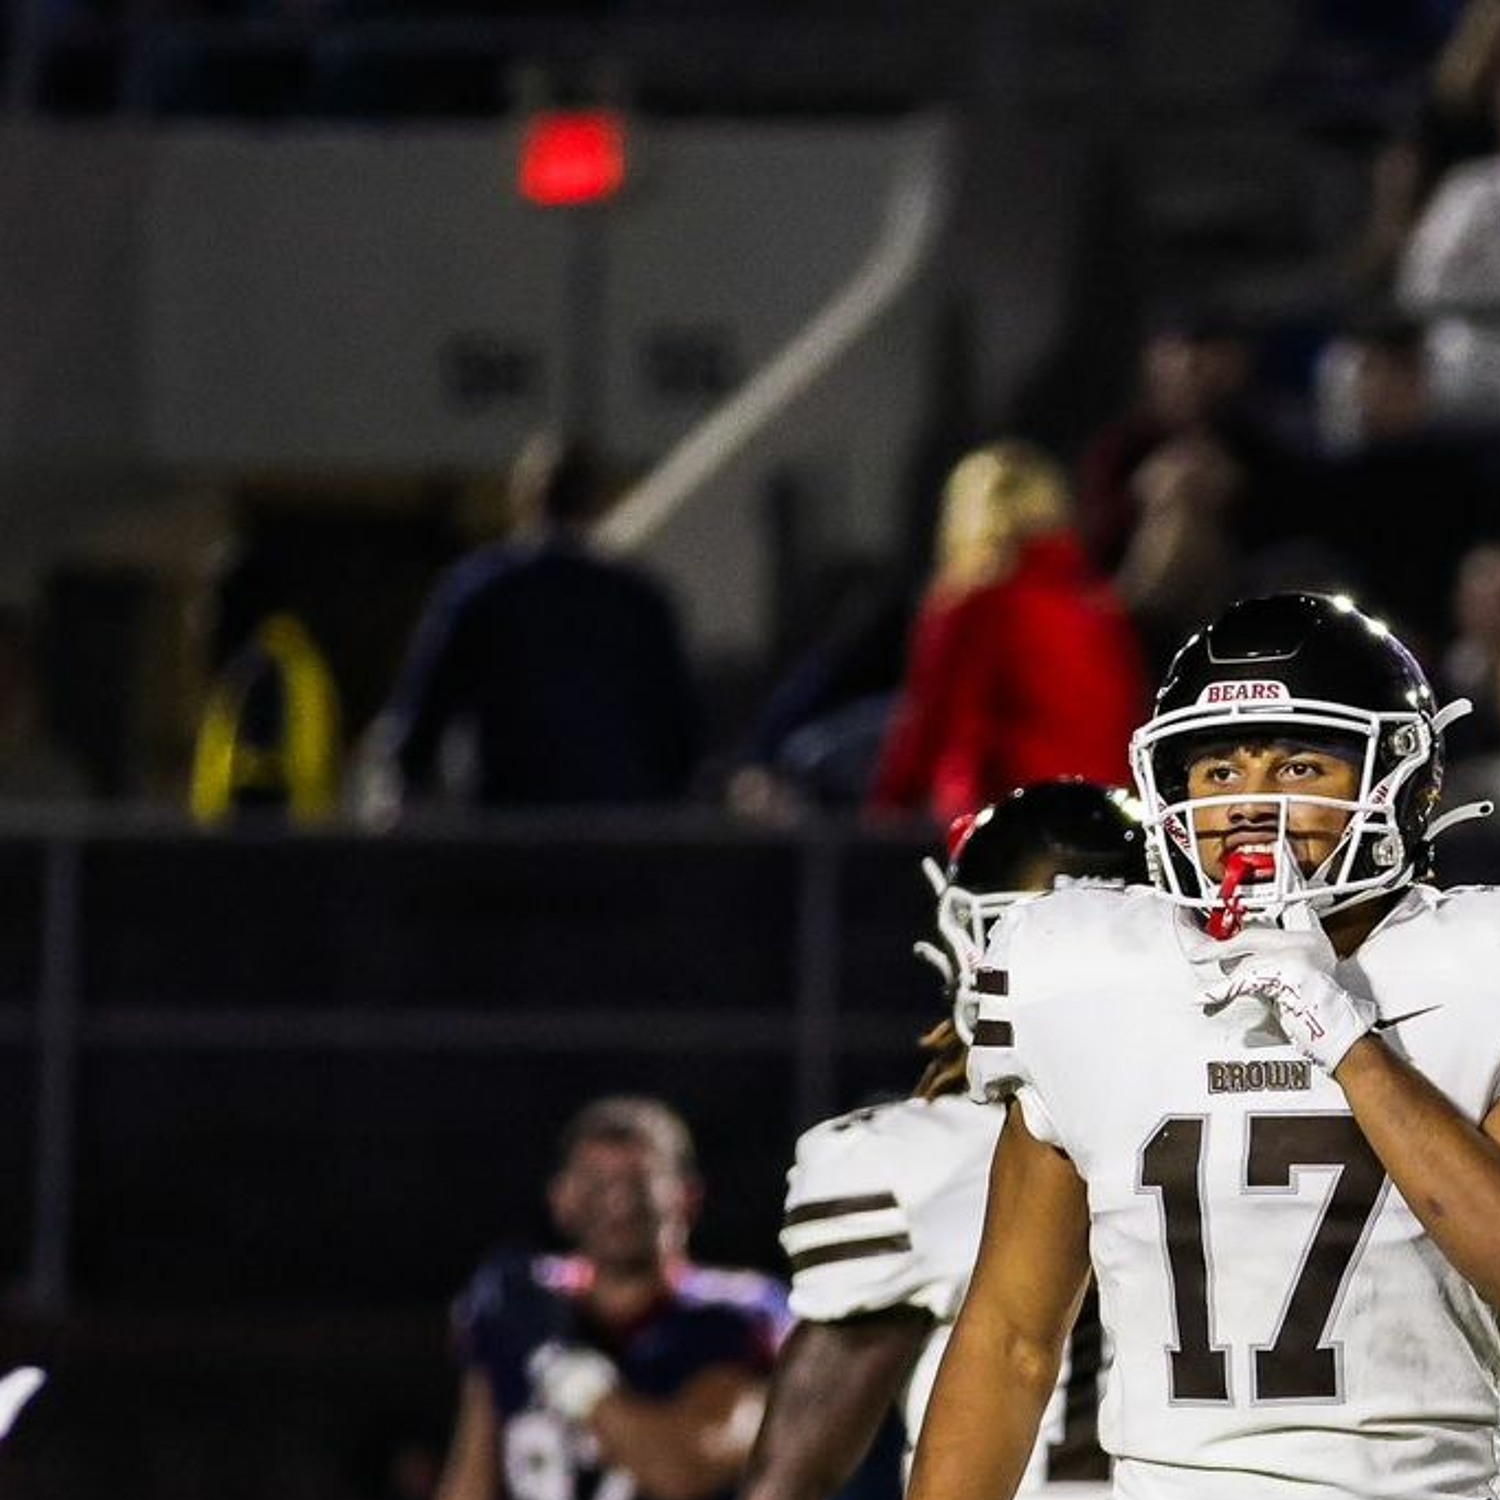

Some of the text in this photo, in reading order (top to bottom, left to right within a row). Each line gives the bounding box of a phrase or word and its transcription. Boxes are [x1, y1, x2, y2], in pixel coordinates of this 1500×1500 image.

[1207, 683, 1280, 703] BEARS
[1207, 1060, 1312, 1094] BROWN
[1134, 1110, 1393, 1407] 17
